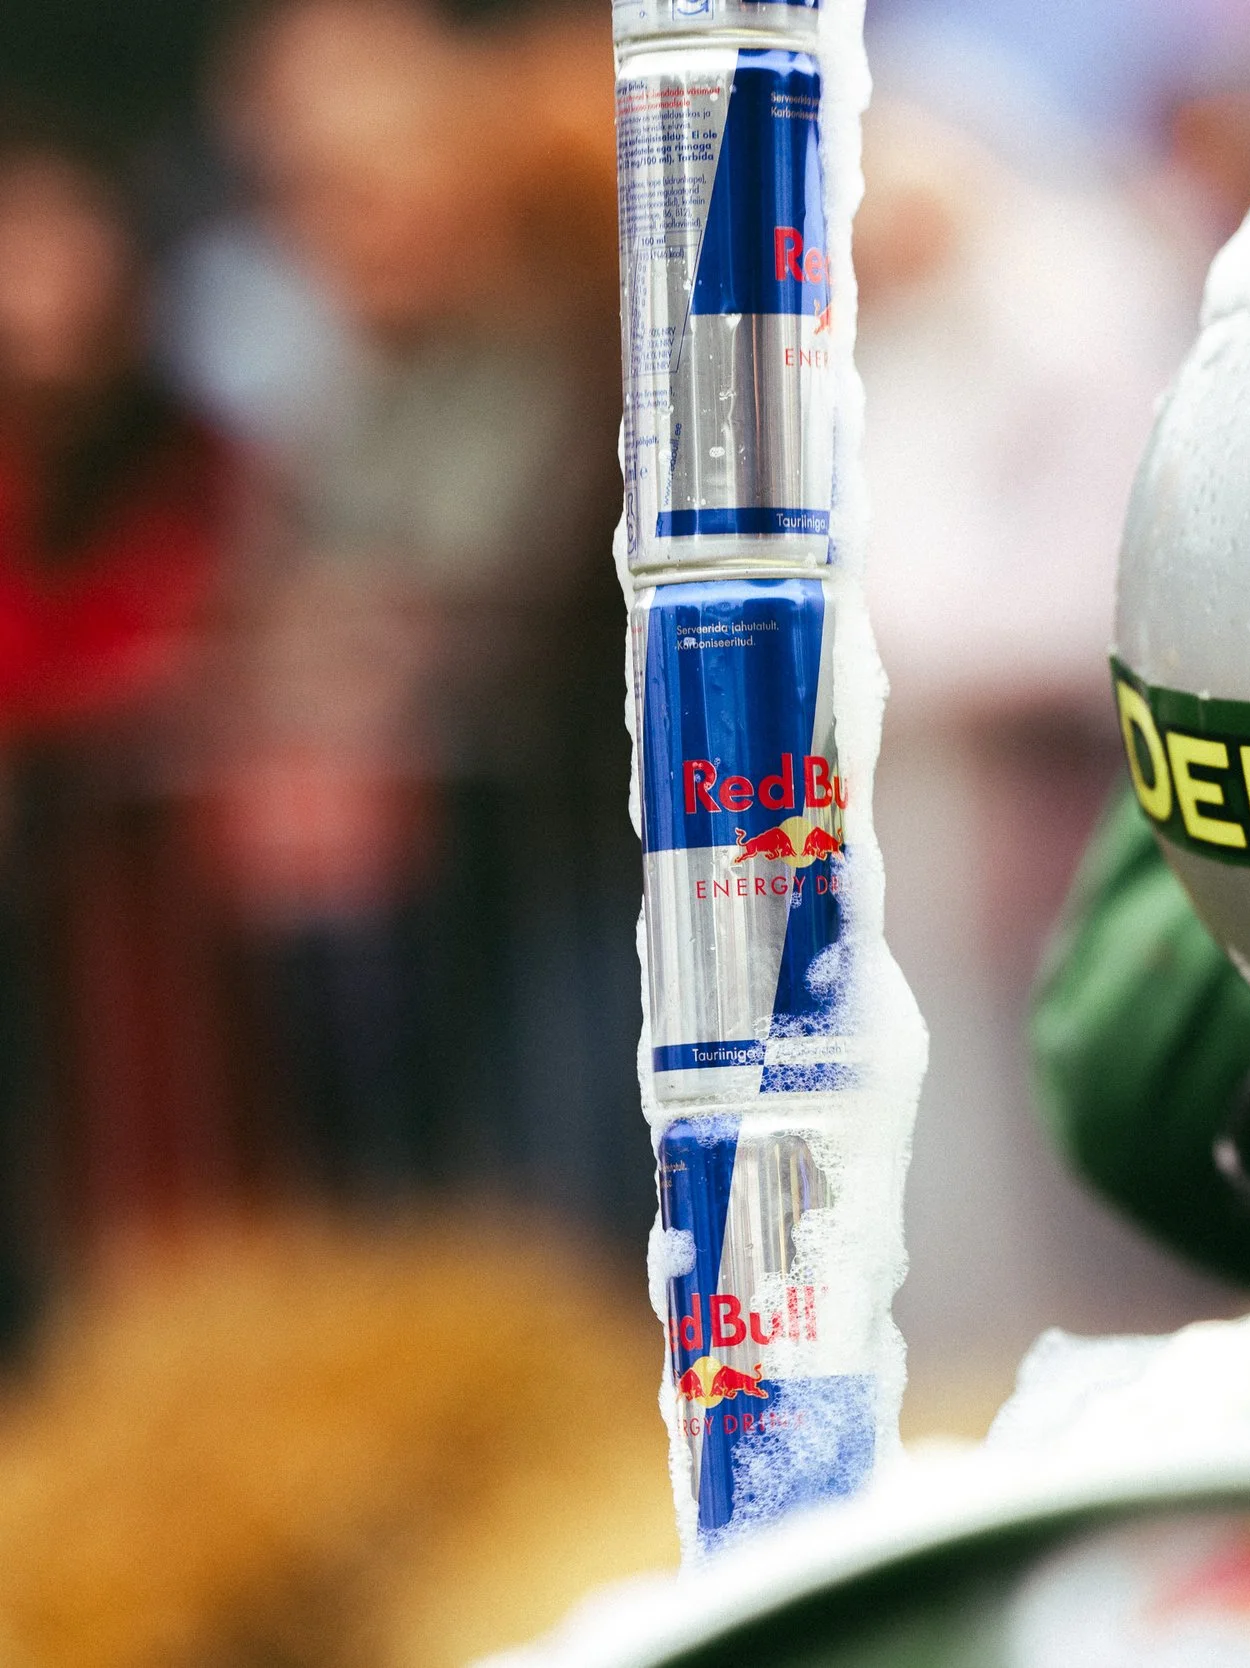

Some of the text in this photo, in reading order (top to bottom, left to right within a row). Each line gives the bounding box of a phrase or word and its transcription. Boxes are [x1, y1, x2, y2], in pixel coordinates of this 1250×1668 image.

[774, 225, 832, 284] Re
[785, 348, 829, 369] ENER
[676, 621, 728, 636] Serveerida
[683, 752, 849, 815] Red Bu
[696, 875, 806, 899] ENERGY
[709, 1286, 817, 1349] Bull
